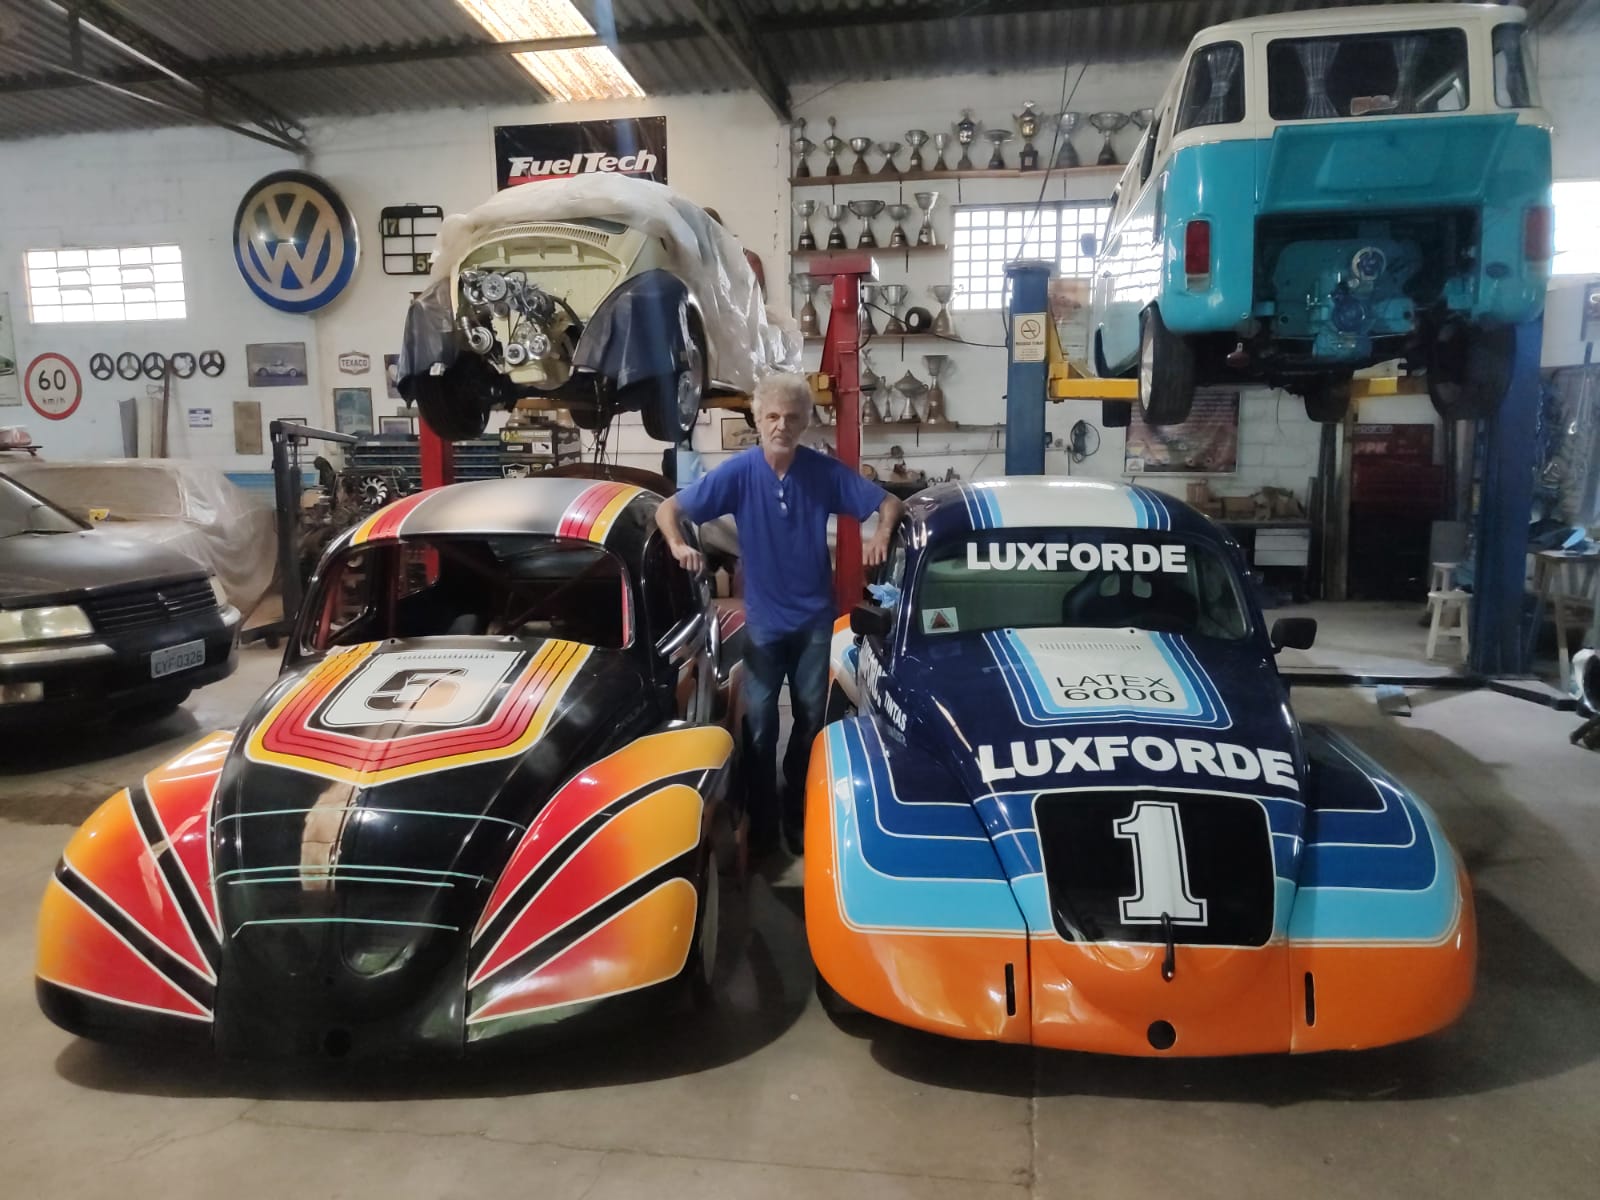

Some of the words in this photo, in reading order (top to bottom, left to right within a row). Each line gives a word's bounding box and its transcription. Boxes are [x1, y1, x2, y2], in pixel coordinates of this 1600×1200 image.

[508, 150, 657, 177] FuelTech
[245, 184, 338, 297] VW
[416, 255, 427, 272] 5
[341, 359, 368, 367] TEXACO
[39, 369, 66, 391] 60
[967, 542, 1188, 574] LUXFORDE
[1056, 674, 1169, 689] LATEX
[1064, 687, 1175, 703] 6000
[883, 690, 907, 732] TINTAS
[978, 736, 1299, 792] LUXFORDE
[1113, 800, 1208, 926] 1
